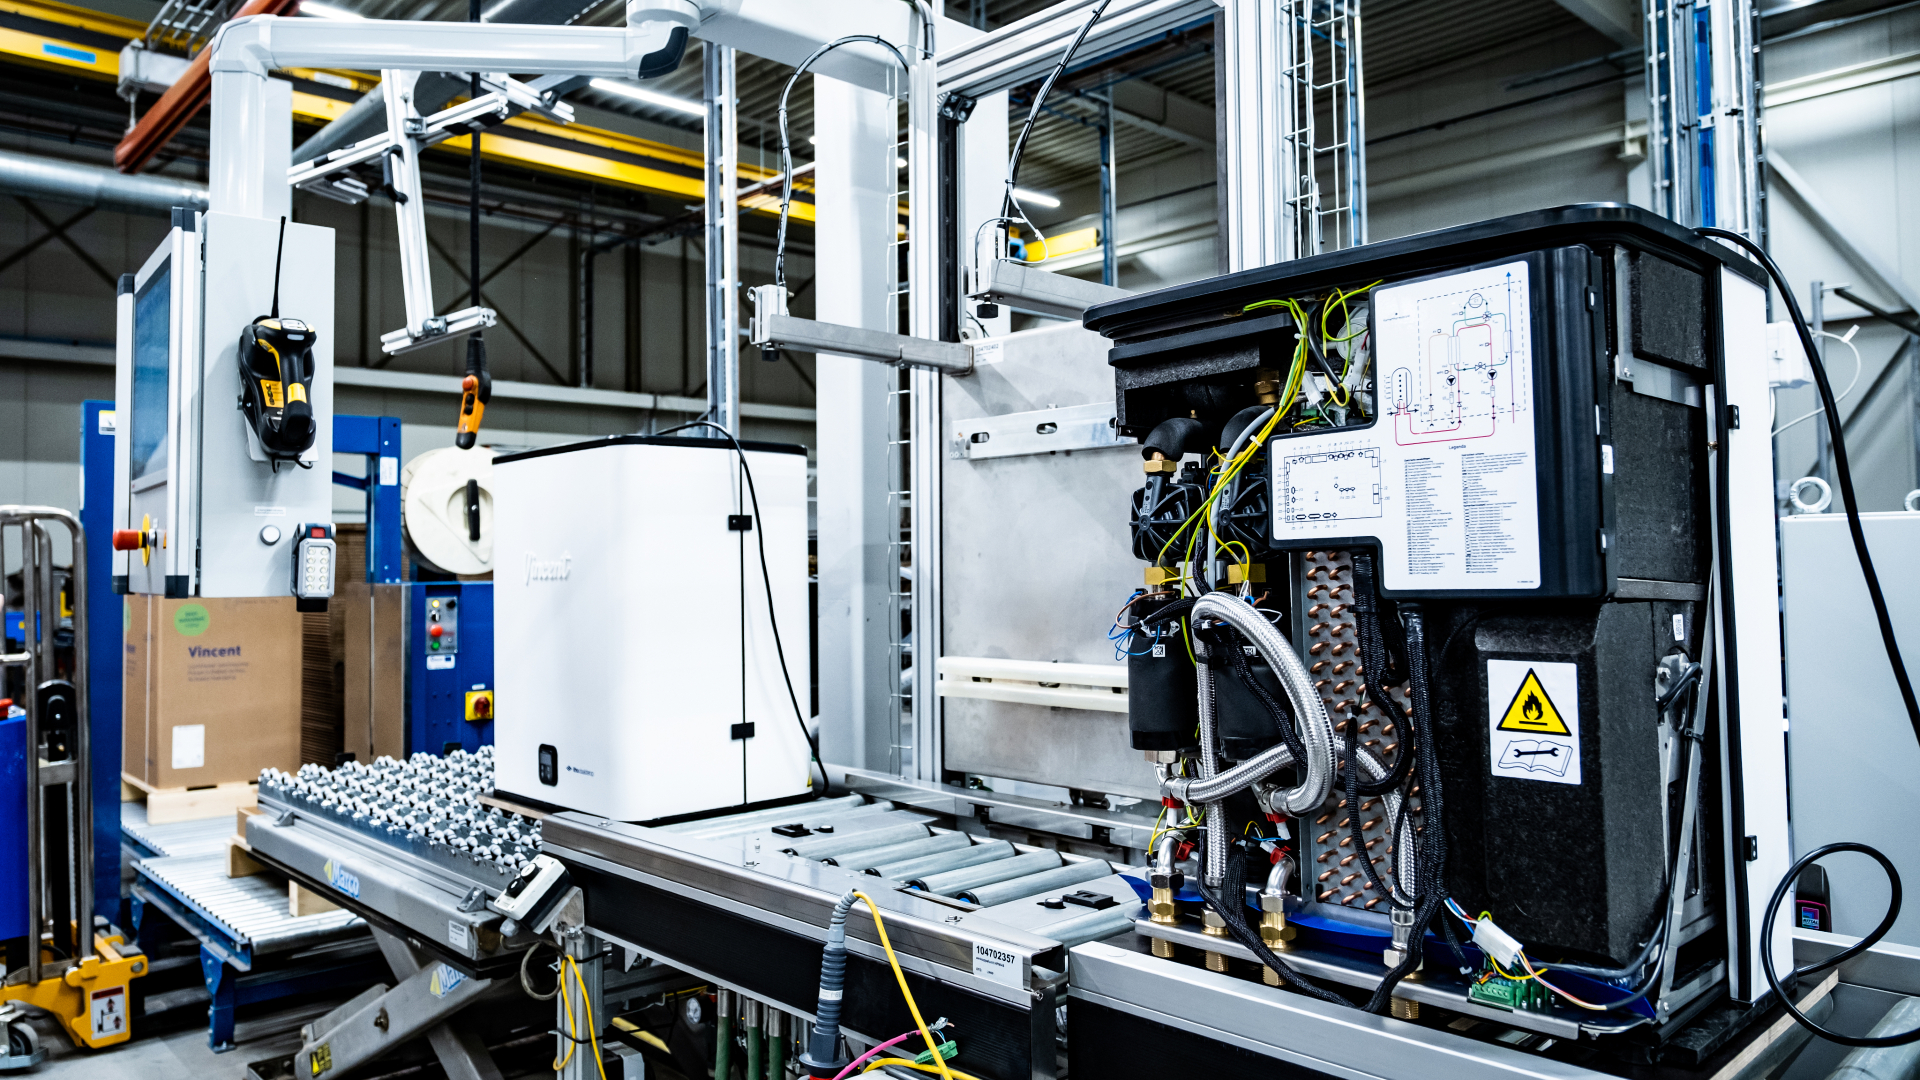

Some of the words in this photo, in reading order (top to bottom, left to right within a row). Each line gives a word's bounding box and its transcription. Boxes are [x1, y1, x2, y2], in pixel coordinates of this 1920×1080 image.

[188, 645, 241, 658] Vincent
[331, 860, 360, 899] Marco
[976, 945, 1015, 964] 104702357
